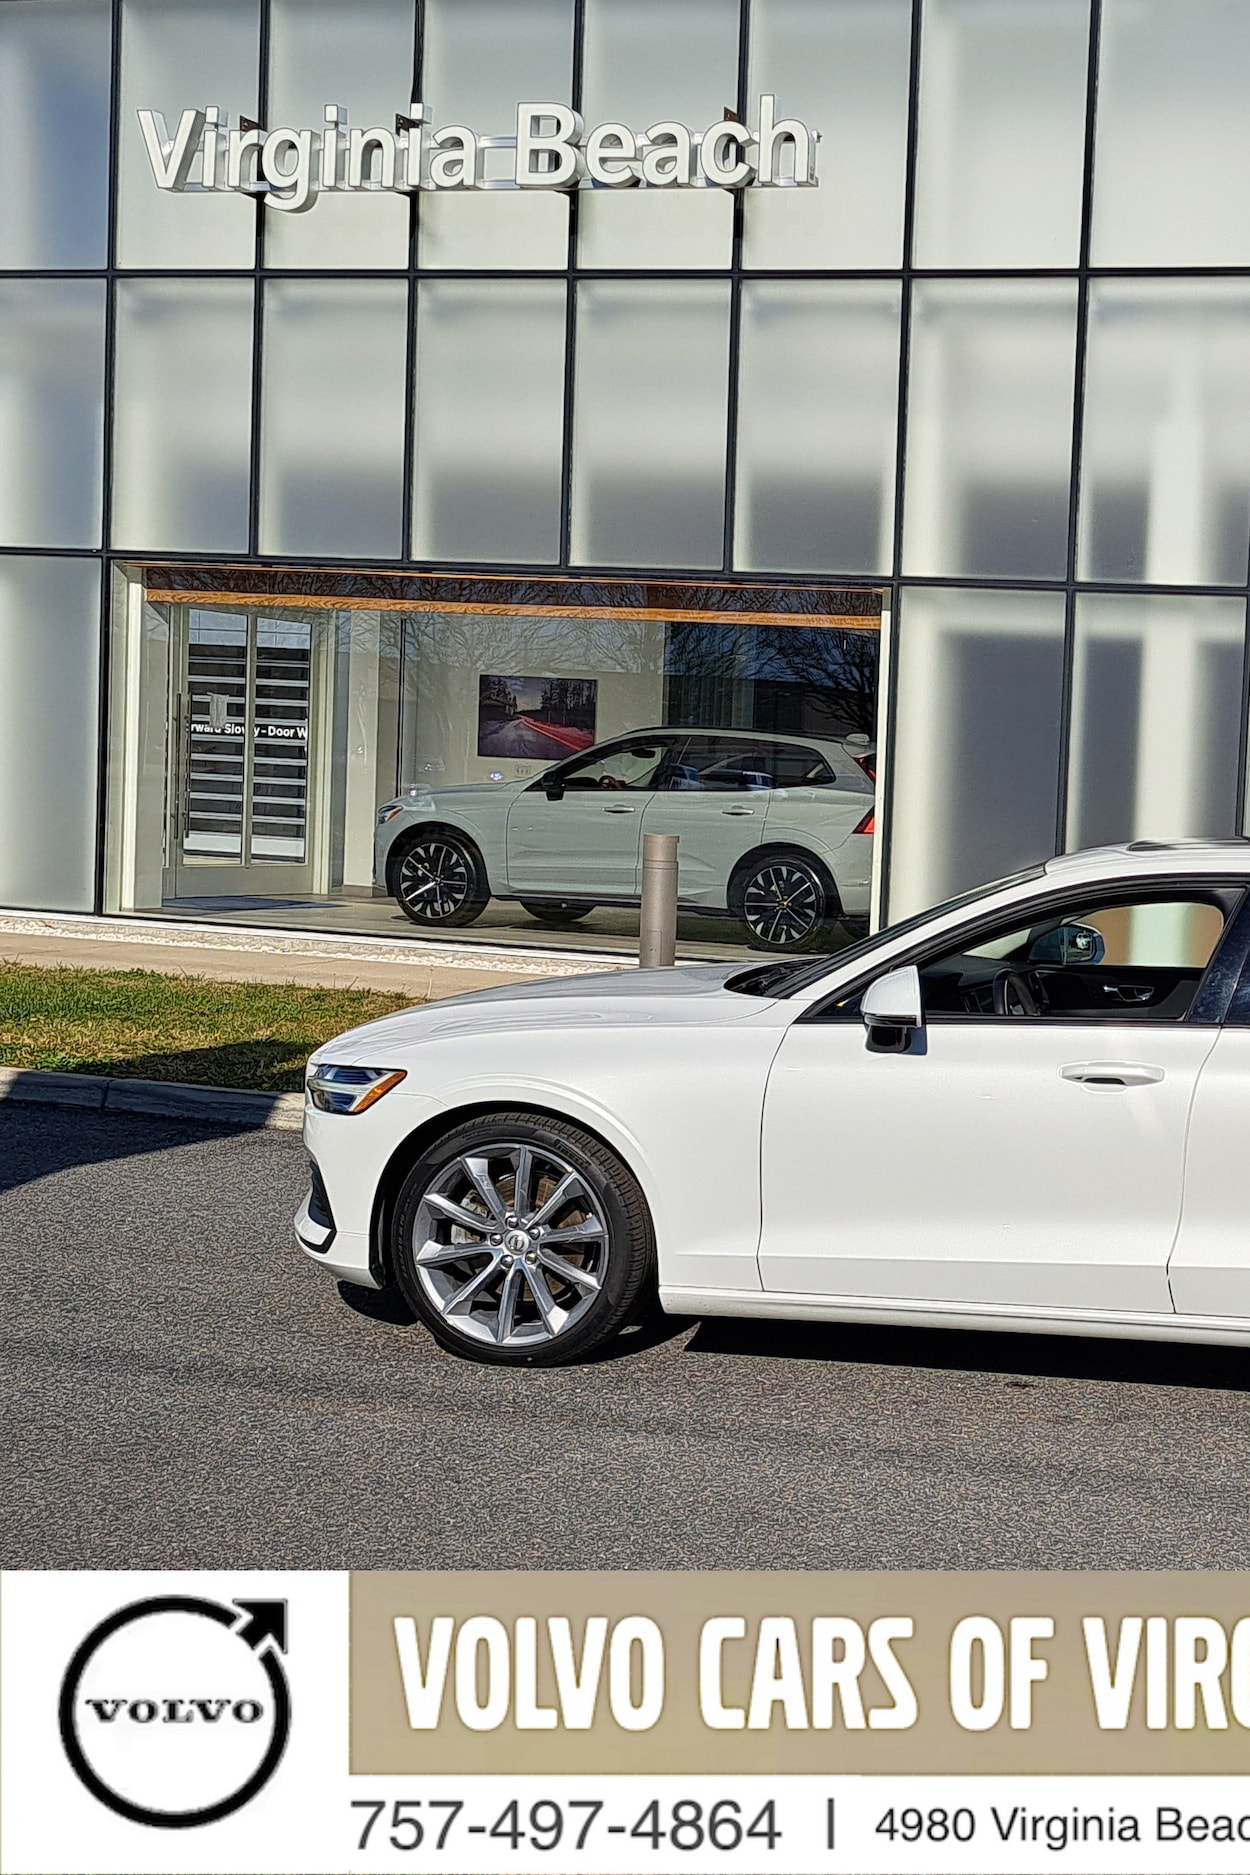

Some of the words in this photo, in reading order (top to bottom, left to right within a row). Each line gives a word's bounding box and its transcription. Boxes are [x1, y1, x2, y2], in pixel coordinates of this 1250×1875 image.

[137, 103, 480, 212] Virginia
[515, 94, 816, 189] Beach
[224, 723, 260, 738] Sloy
[268, 725, 295, 738] Door
